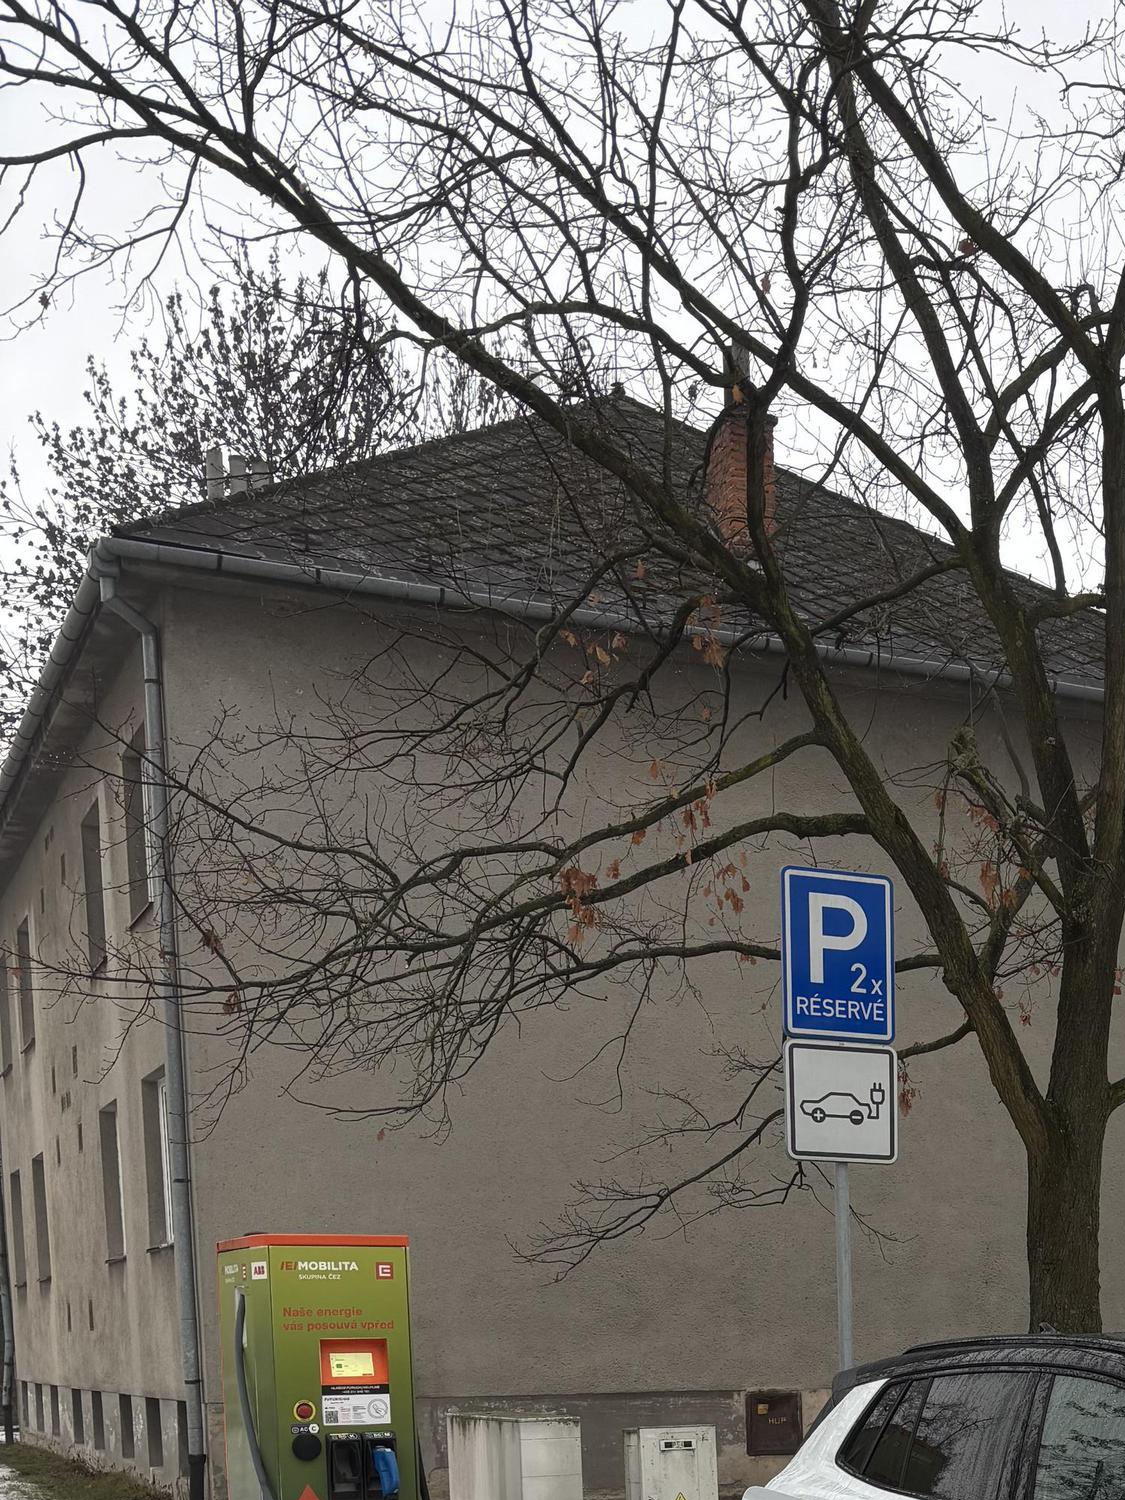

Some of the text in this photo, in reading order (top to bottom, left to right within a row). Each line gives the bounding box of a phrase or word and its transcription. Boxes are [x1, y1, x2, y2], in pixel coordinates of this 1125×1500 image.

[809, 892, 867, 984] P
[796, 993, 885, 1022] RÉSERVÉ
[253, 1265, 266, 1276] ABB
[283, 1307, 363, 1318] Naše energie
